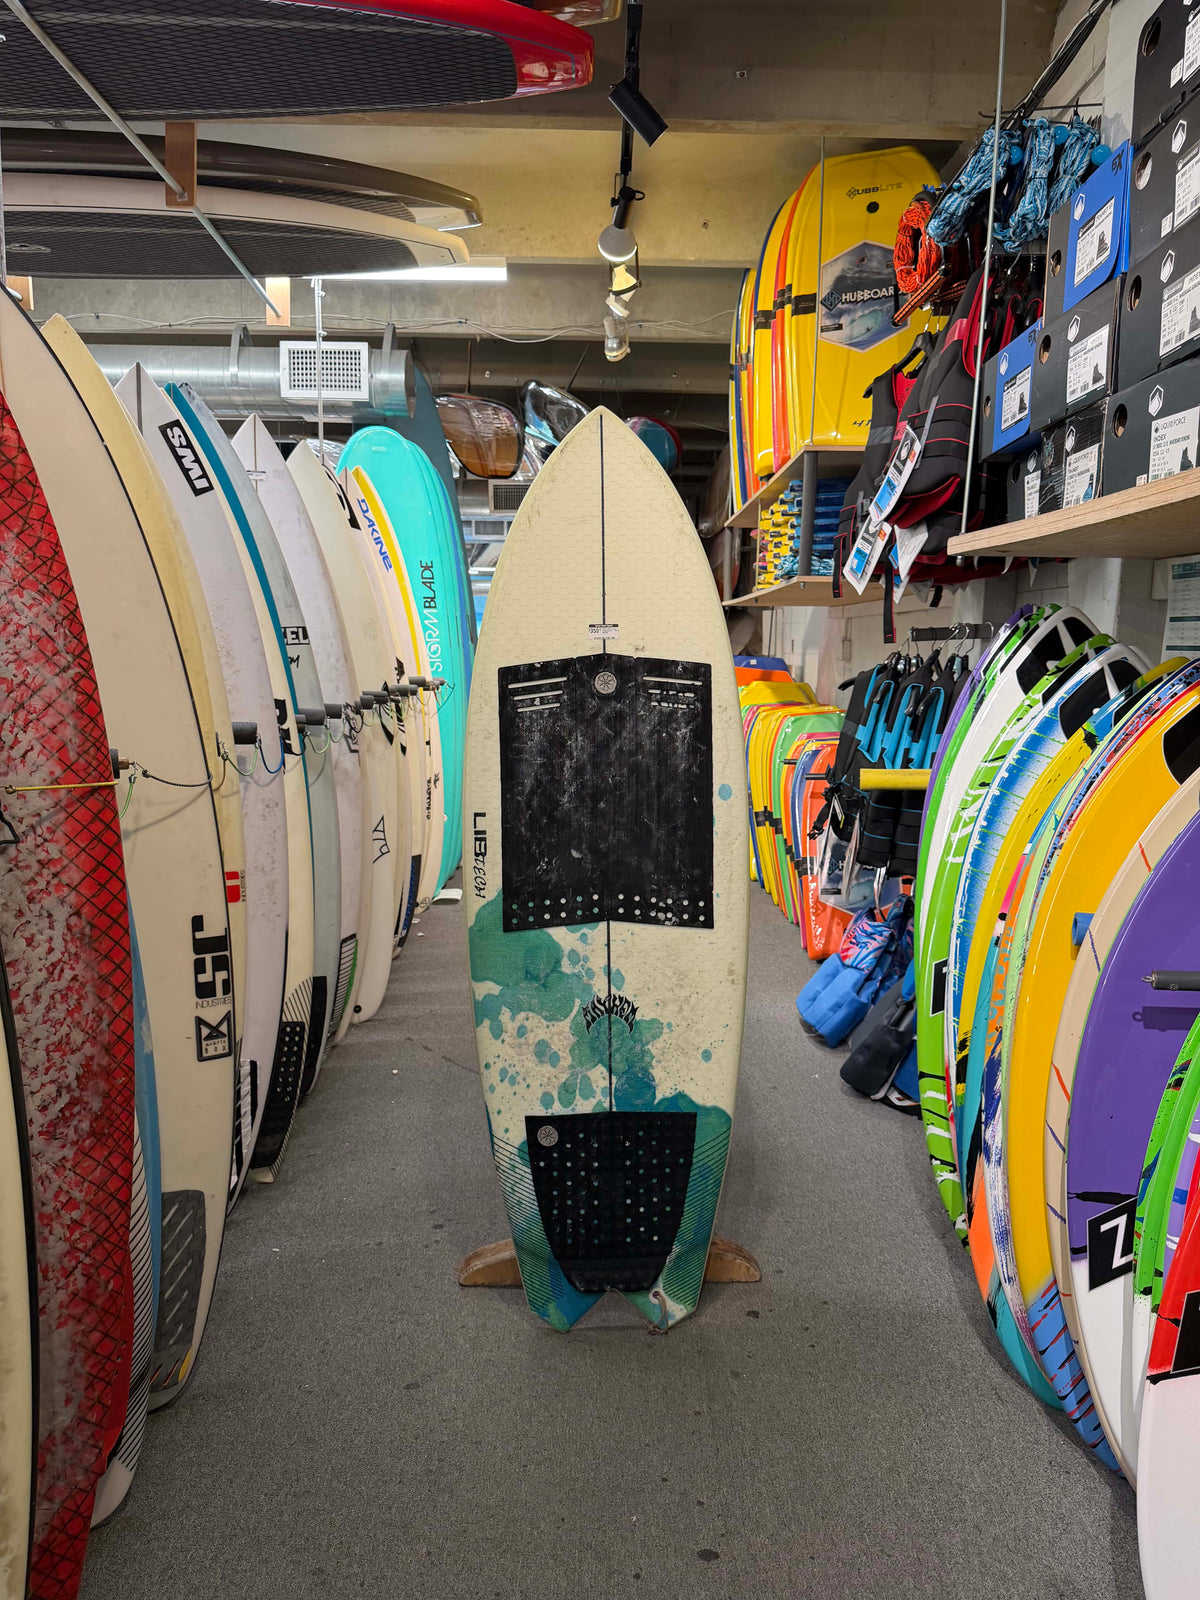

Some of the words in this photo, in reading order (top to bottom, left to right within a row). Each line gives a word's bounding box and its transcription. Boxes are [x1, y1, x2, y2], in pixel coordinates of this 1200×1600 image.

[166, 426, 210, 489] SMI
[357, 498, 393, 573] DAKINE
[195, 997, 232, 1009] INDUSTRIES
